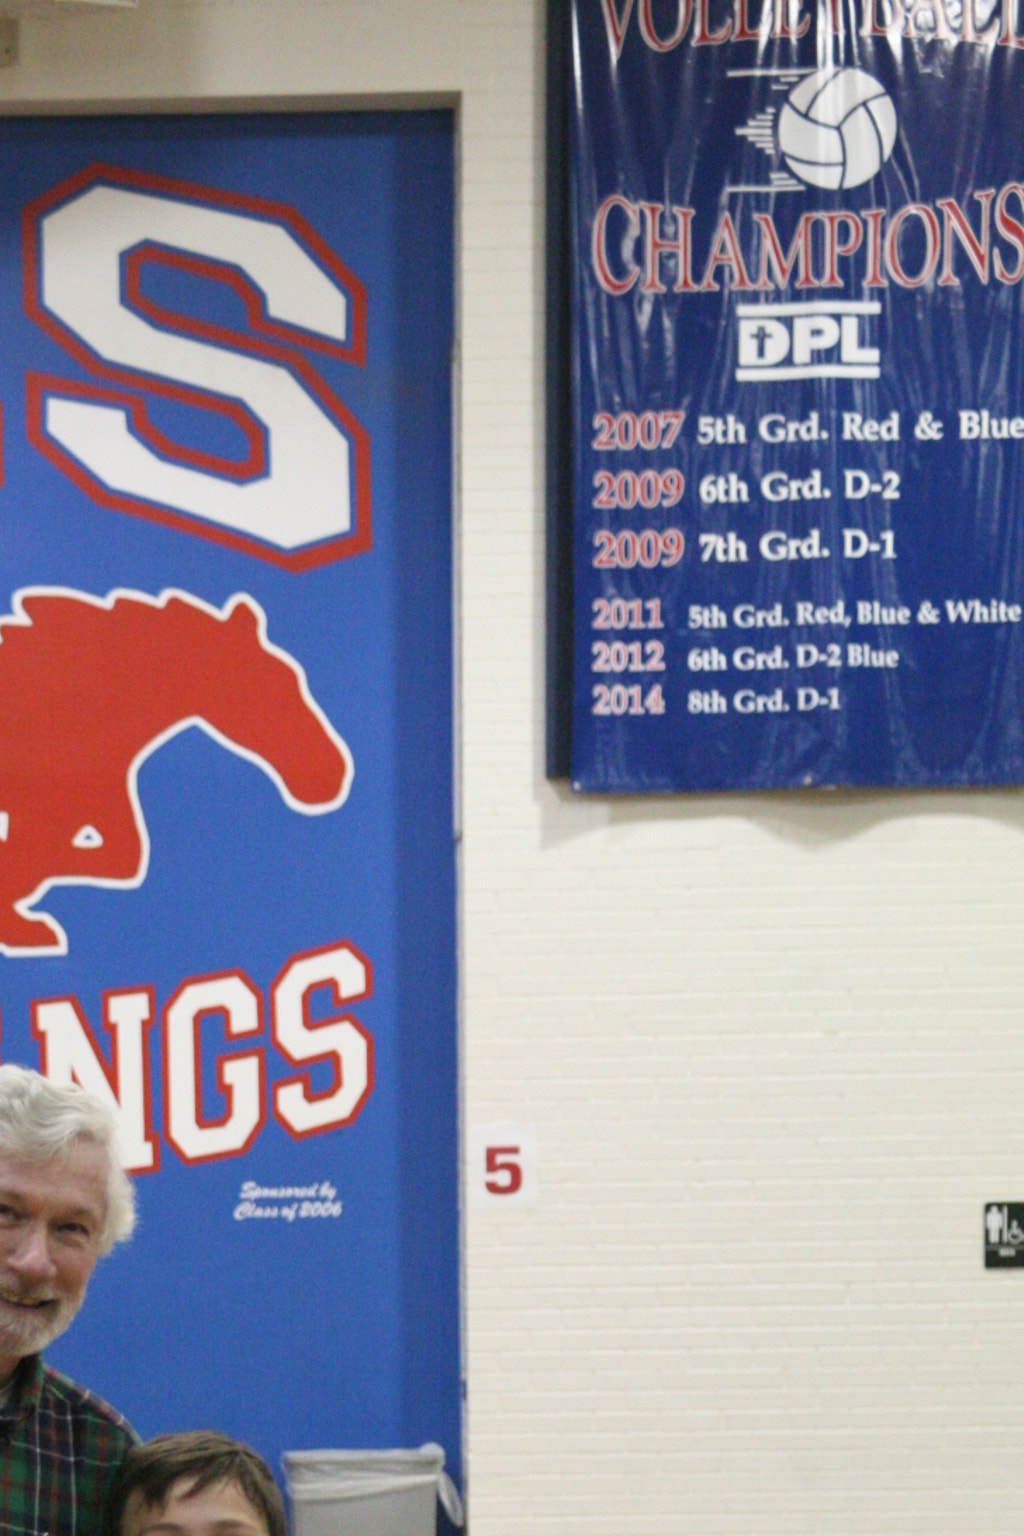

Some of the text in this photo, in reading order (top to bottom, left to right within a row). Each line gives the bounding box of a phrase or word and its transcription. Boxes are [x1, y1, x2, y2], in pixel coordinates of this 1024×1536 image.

[600, 0, 1024, 59] VOLLEBALL
[591, 181, 1024, 296] CHAMPIONS
[738, 315, 880, 367] DPL
[591, 409, 1024, 450] 2007 5th Grd. Red & Blue
[592, 470, 901, 509] 2009 6th Grd. D-2
[592, 529, 897, 568] 2009 7th Grd. D-1
[591, 598, 1023, 629] 2011 5th Grd. Red, Blue & White
[591, 641, 900, 672] 2012 6th Grd. D-2 Blue
[591, 684, 842, 715] 2014 8th Grd. D-1
[484, 1146, 523, 1196] 5
[239, 1181, 337, 1201] Sponsored by
[233, 1200, 343, 1223] Class of 2006
